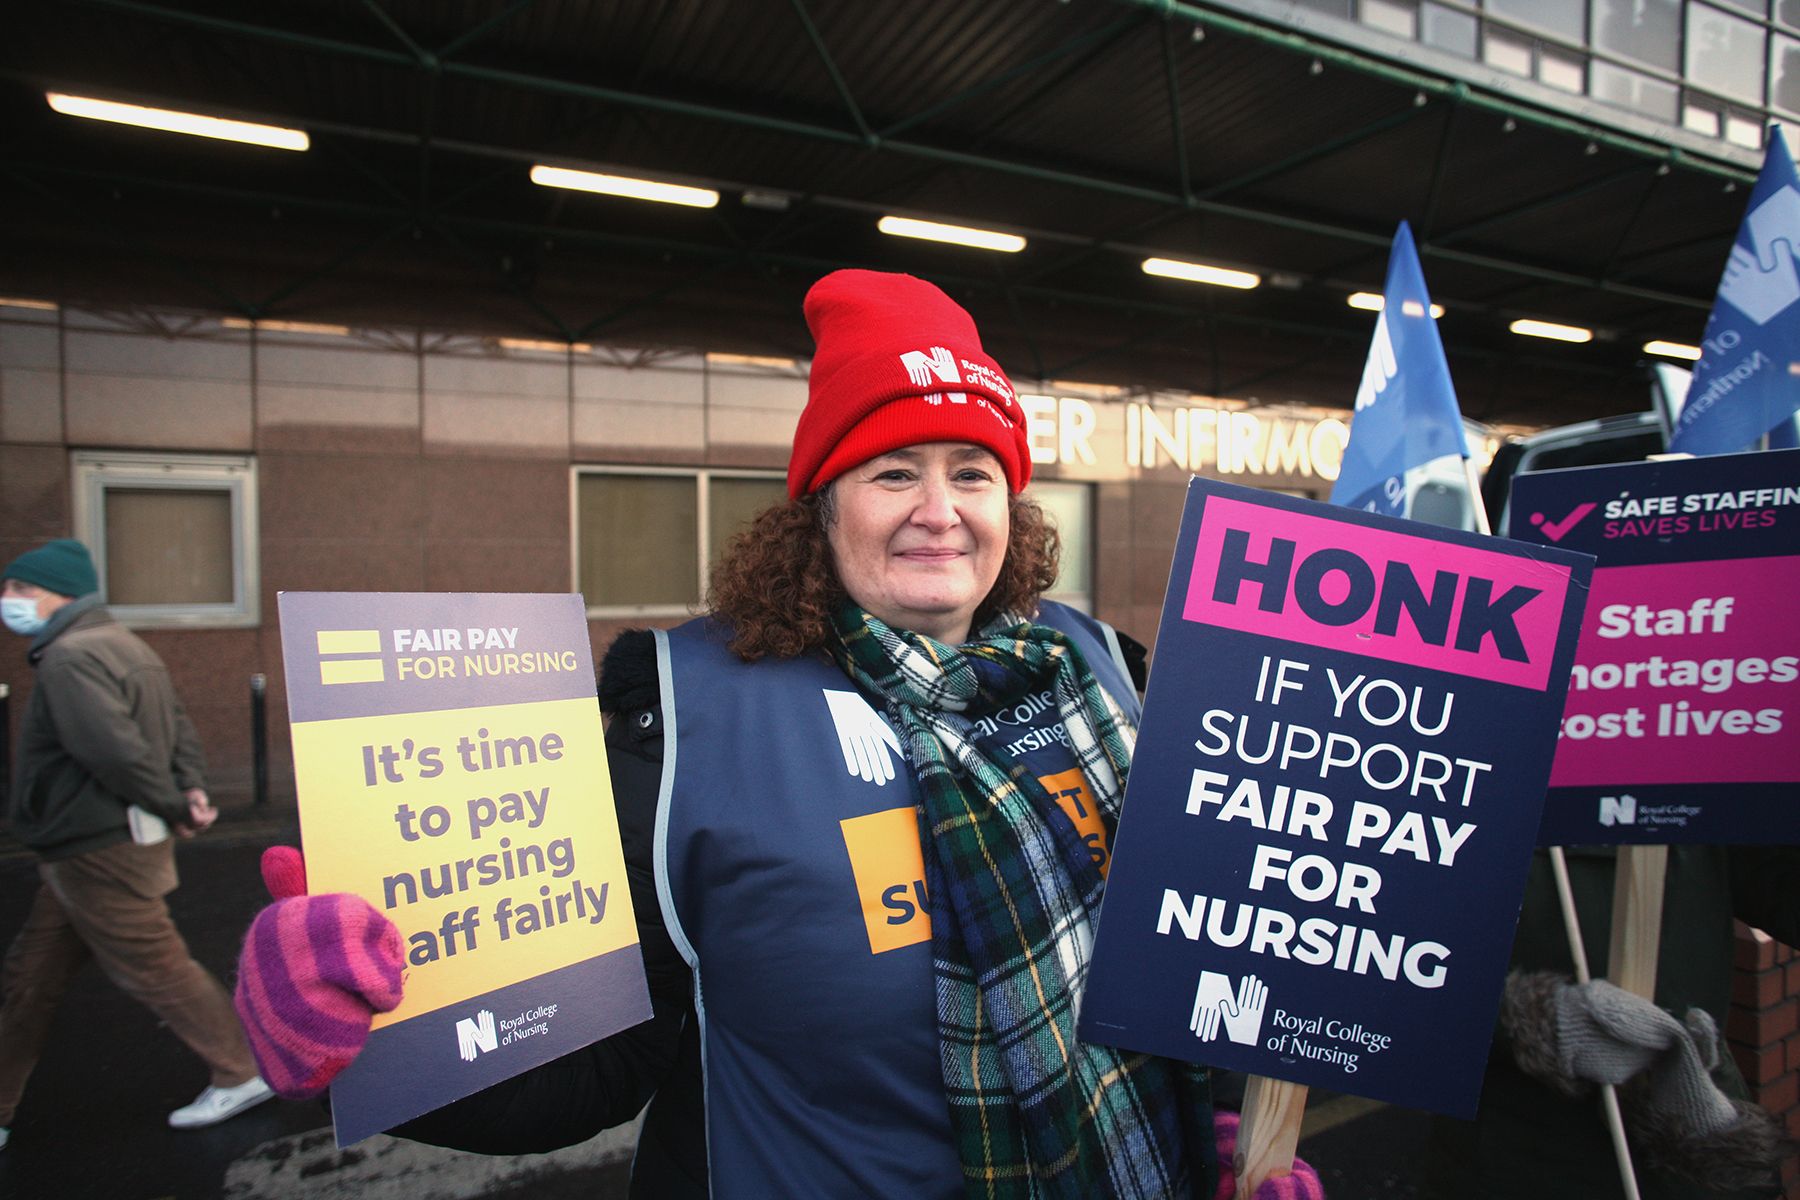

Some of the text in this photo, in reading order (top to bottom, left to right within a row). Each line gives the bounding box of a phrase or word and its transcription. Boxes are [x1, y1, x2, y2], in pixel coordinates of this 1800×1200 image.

[966, 372, 979, 385] of
[1603, 510, 1777, 539] SAVES LIVES
[1604, 496, 1677, 519] SAFE
[1211, 527, 1545, 665] HONK
[1597, 597, 1735, 639] Staff
[393, 627, 519, 652] FAIR PAY
[397, 650, 578, 681] FOR NURSING
[1255, 655, 1454, 737] IF YOU
[1558, 701, 1784, 740] ost lives
[362, 727, 565, 786] It's time
[1195, 709, 1492, 807] SUPPORT
[394, 786, 550, 842] to pay
[1185, 768, 1477, 867] FAIR PAY
[382, 836, 576, 909] nursing
[1248, 844, 1382, 914] FOR
[402, 880, 610, 971] aff fairly
[1156, 888, 1451, 989] NURSING
[500, 1002, 558, 1034] Royal College
[501, 1020, 549, 1047] of Nursing
[1272, 1009, 1391, 1054] Royal College
[1267, 1035, 1360, 1075] of Nursing
